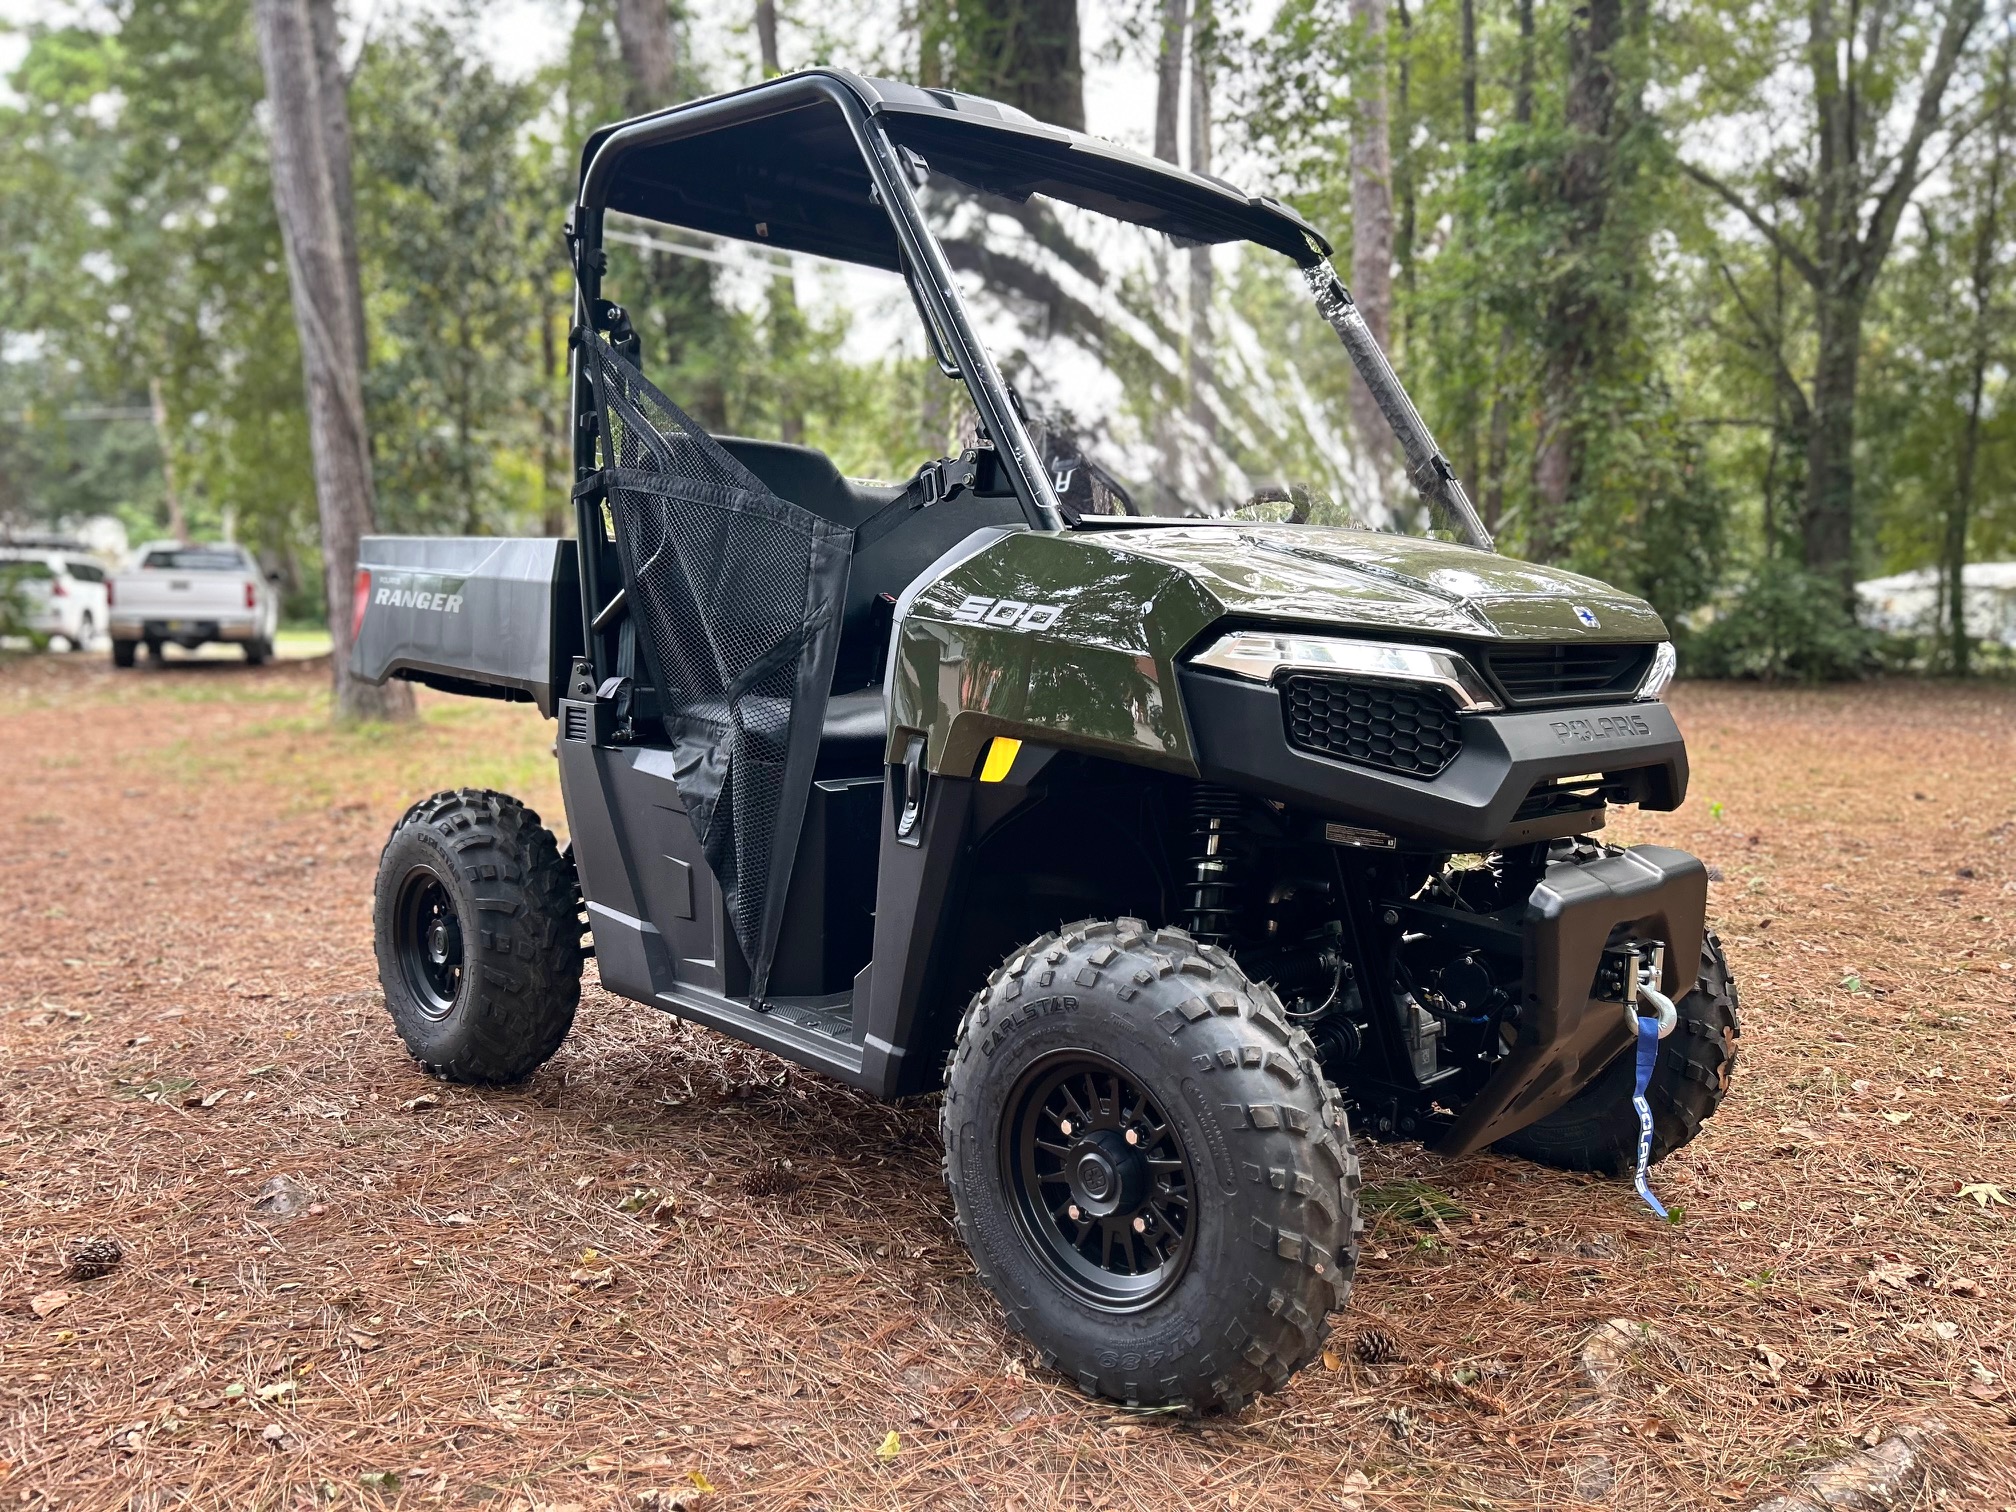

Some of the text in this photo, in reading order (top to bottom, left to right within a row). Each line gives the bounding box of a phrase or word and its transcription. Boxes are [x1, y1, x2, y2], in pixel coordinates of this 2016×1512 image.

[375, 587, 464, 613] RANGER
[952, 595, 1064, 631] 500
[1549, 715, 1652, 744] POLARIS
[981, 995, 1079, 1058] CARLSTAR
[1633, 1096, 1652, 1194] POLARIS
